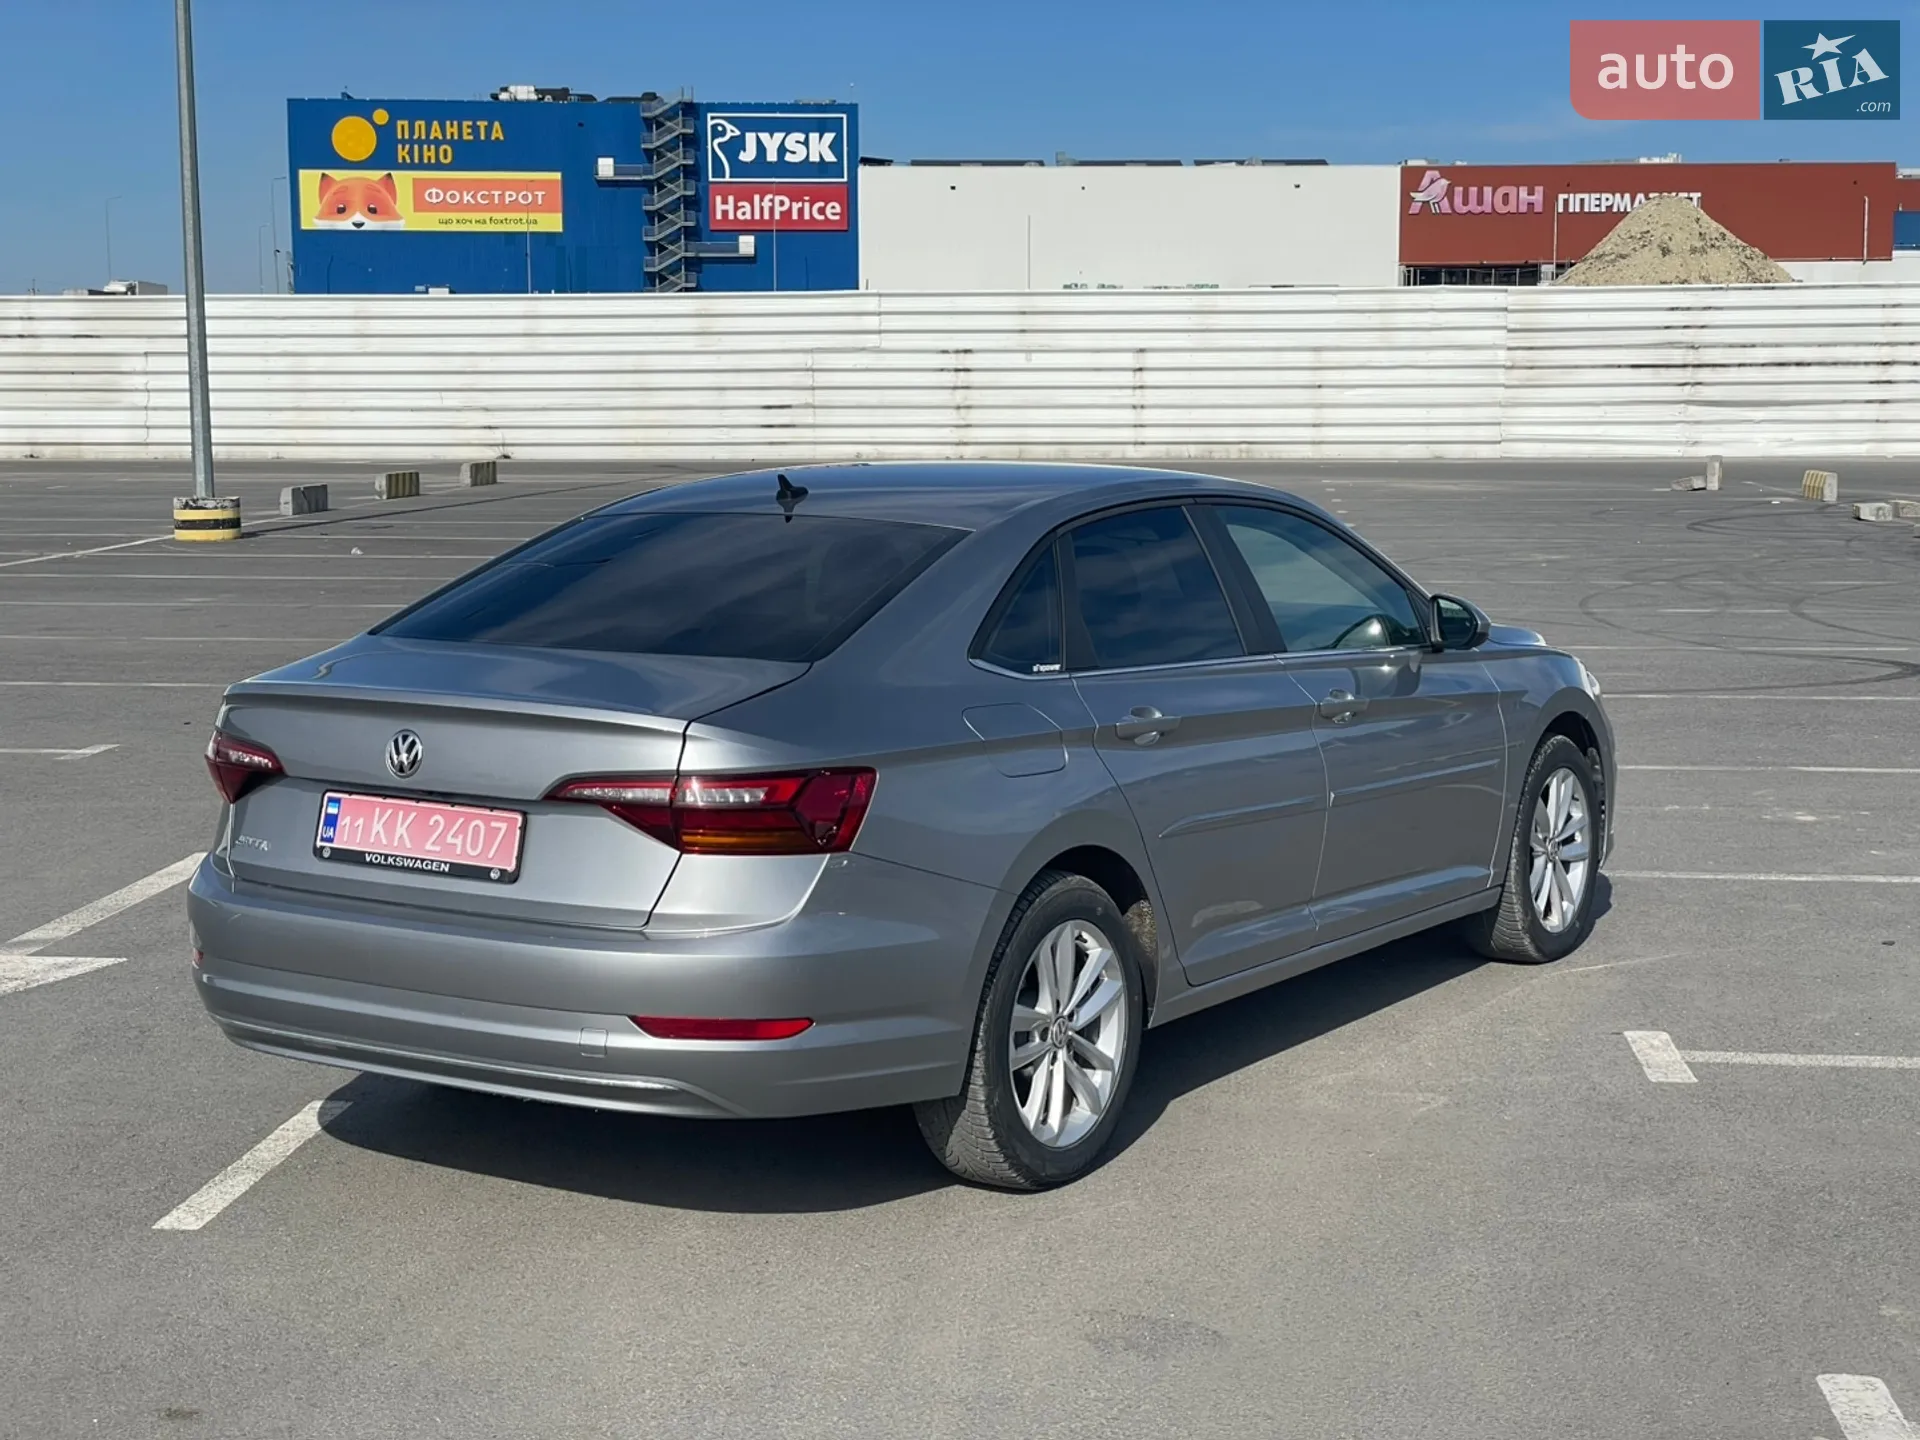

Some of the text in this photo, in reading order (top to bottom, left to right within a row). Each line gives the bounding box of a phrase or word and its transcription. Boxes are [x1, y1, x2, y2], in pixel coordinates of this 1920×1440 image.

[396, 119, 505, 141] ПЛАНЕТА
[396, 144, 454, 164] КІНО
[738, 132, 838, 163] JYSK
[424, 187, 547, 206] ФОКСТРОТ
[1408, 170, 1702, 214] Ашан ГІПЕРМАТ
[714, 193, 842, 221] HalfPrice
[438, 216, 538, 226] що хоч на foxtrot.ua
[322, 826, 335, 839] UA
[424, 814, 509, 860] 2407
[364, 852, 451, 874] VOLKSWAGEN
